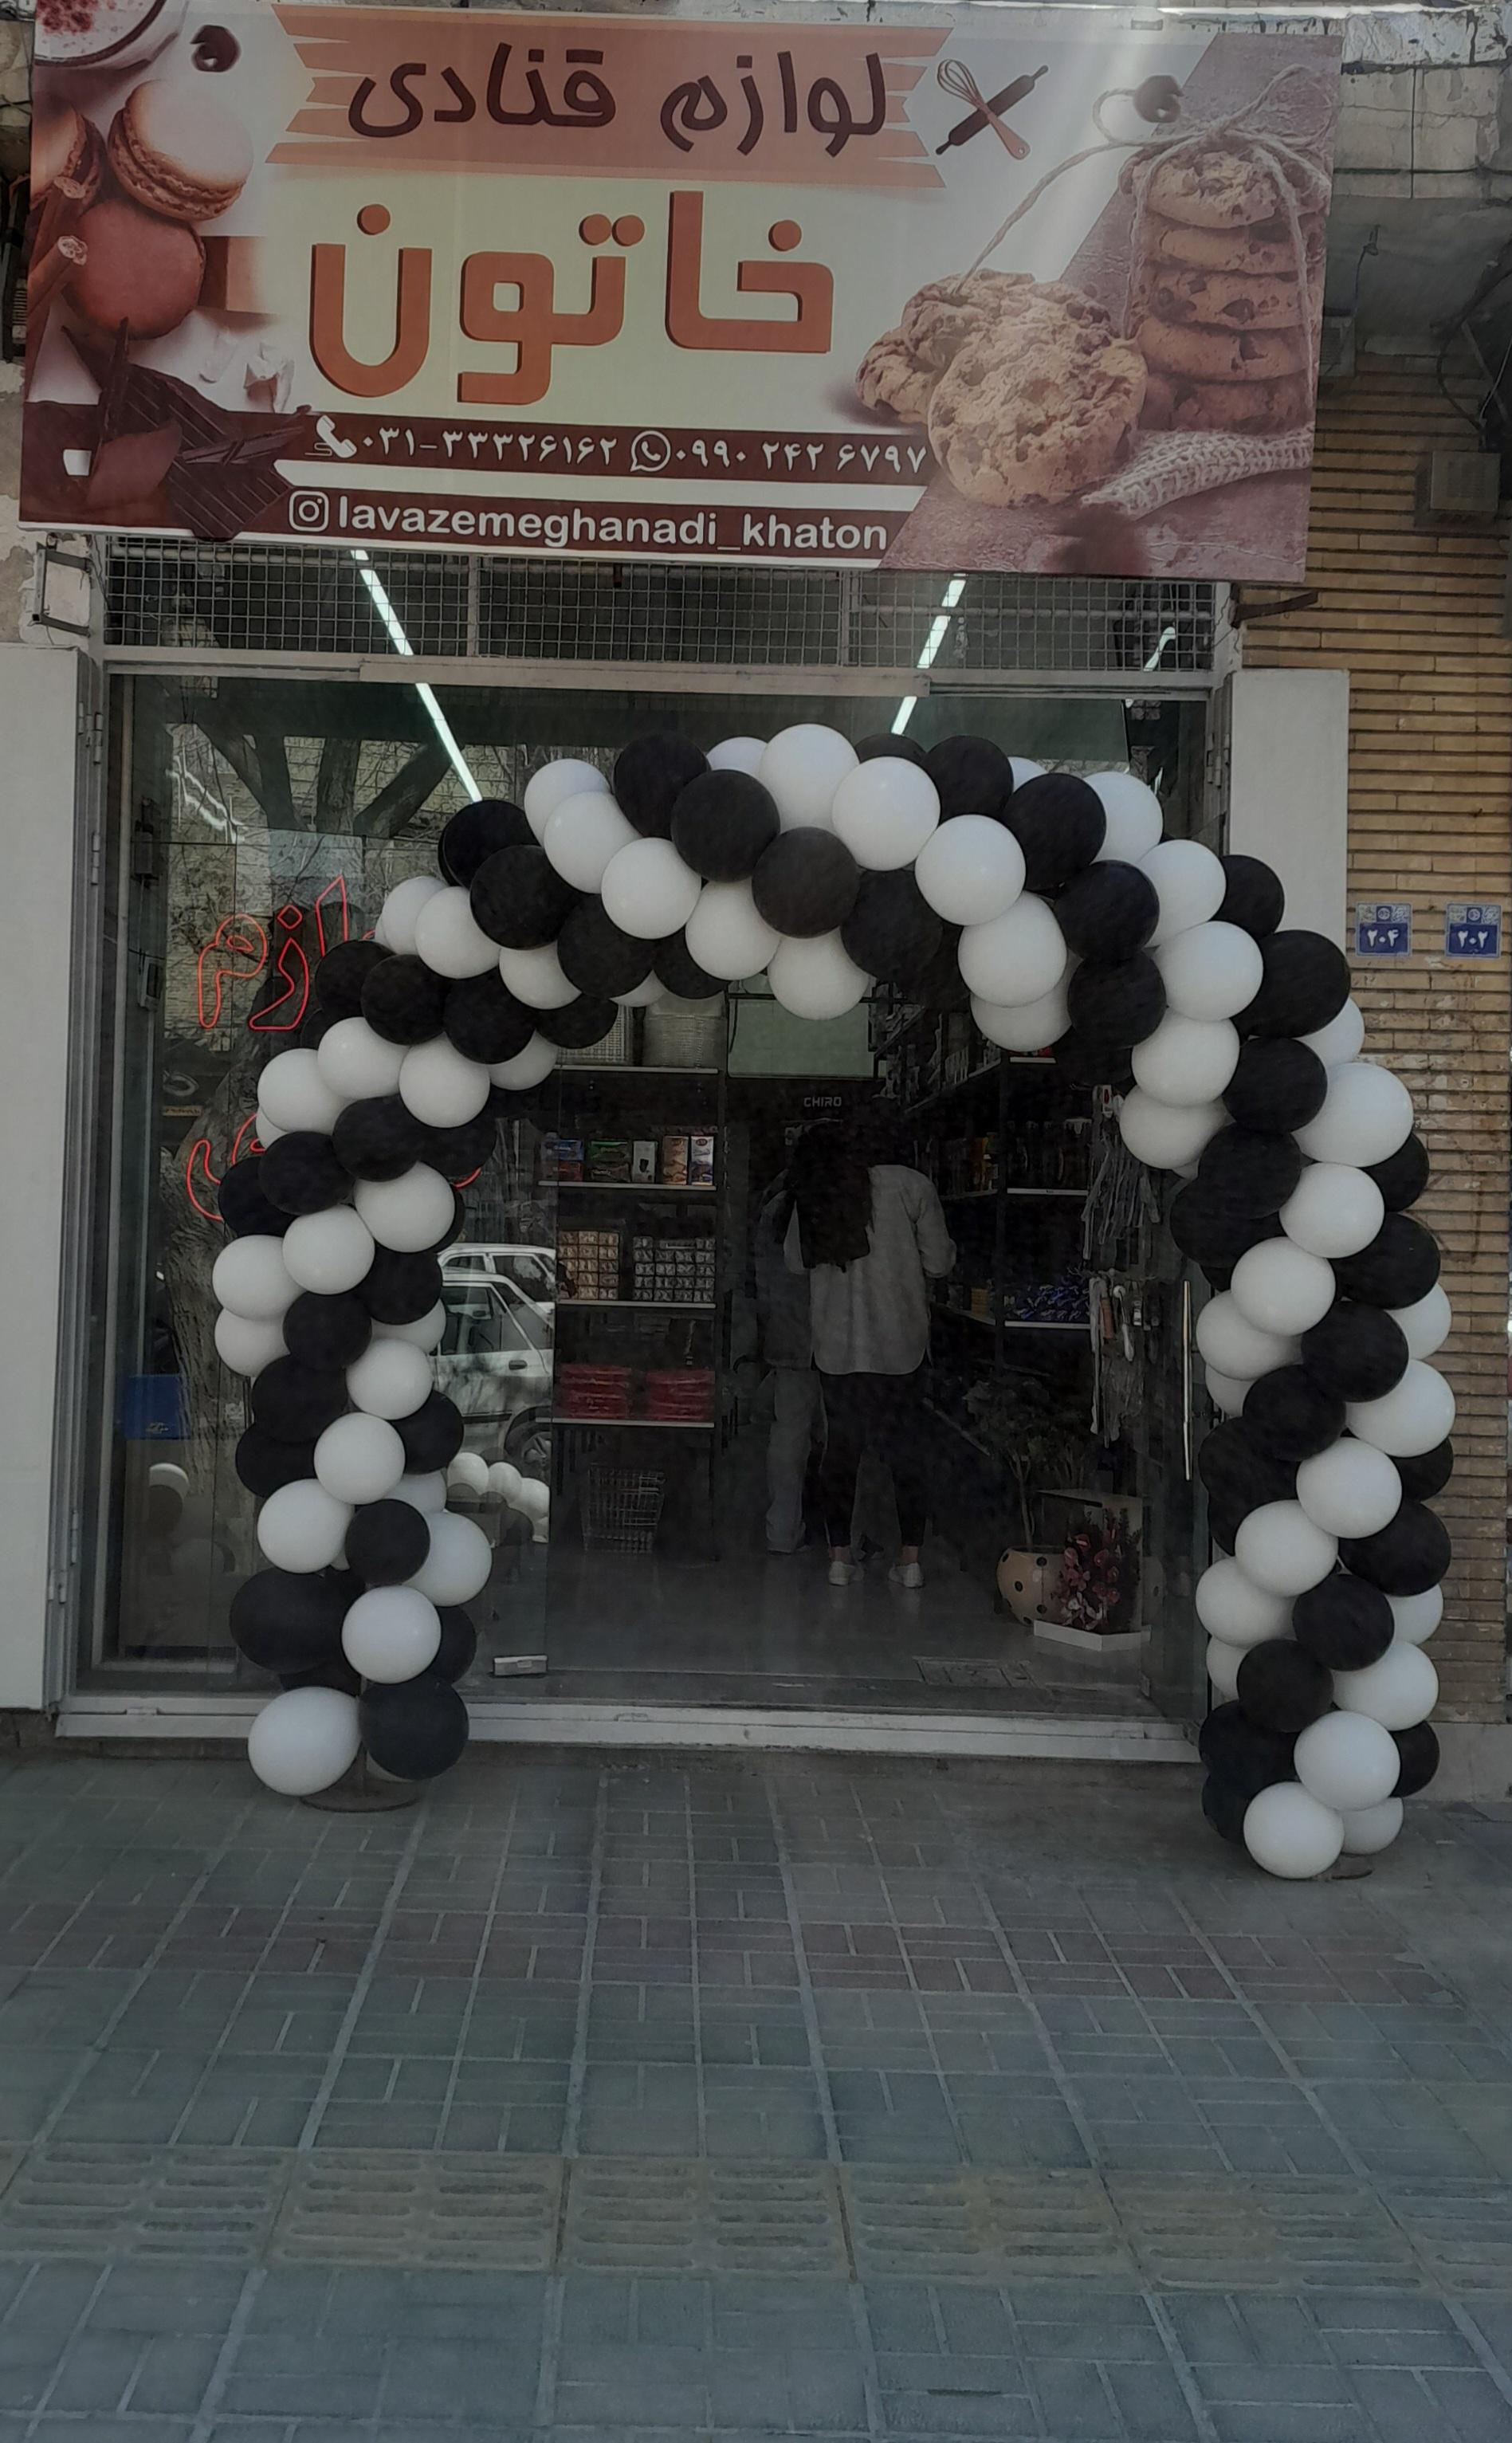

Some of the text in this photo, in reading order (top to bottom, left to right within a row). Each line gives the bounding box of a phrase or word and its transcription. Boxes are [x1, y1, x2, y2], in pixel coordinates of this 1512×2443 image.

[348, 42, 886, 156] لوازم قنادی
[308, 190, 835, 405] خاتون
[761, 440, 824, 471] ۲۴۲
[837, 444, 927, 473] ۶۷۹۷
[339, 496, 888, 552] lavazemeghanadi_khaton
[1367, 929, 1400, 947] ۲۰۴
[803, 1096, 842, 1108] CHIRO
